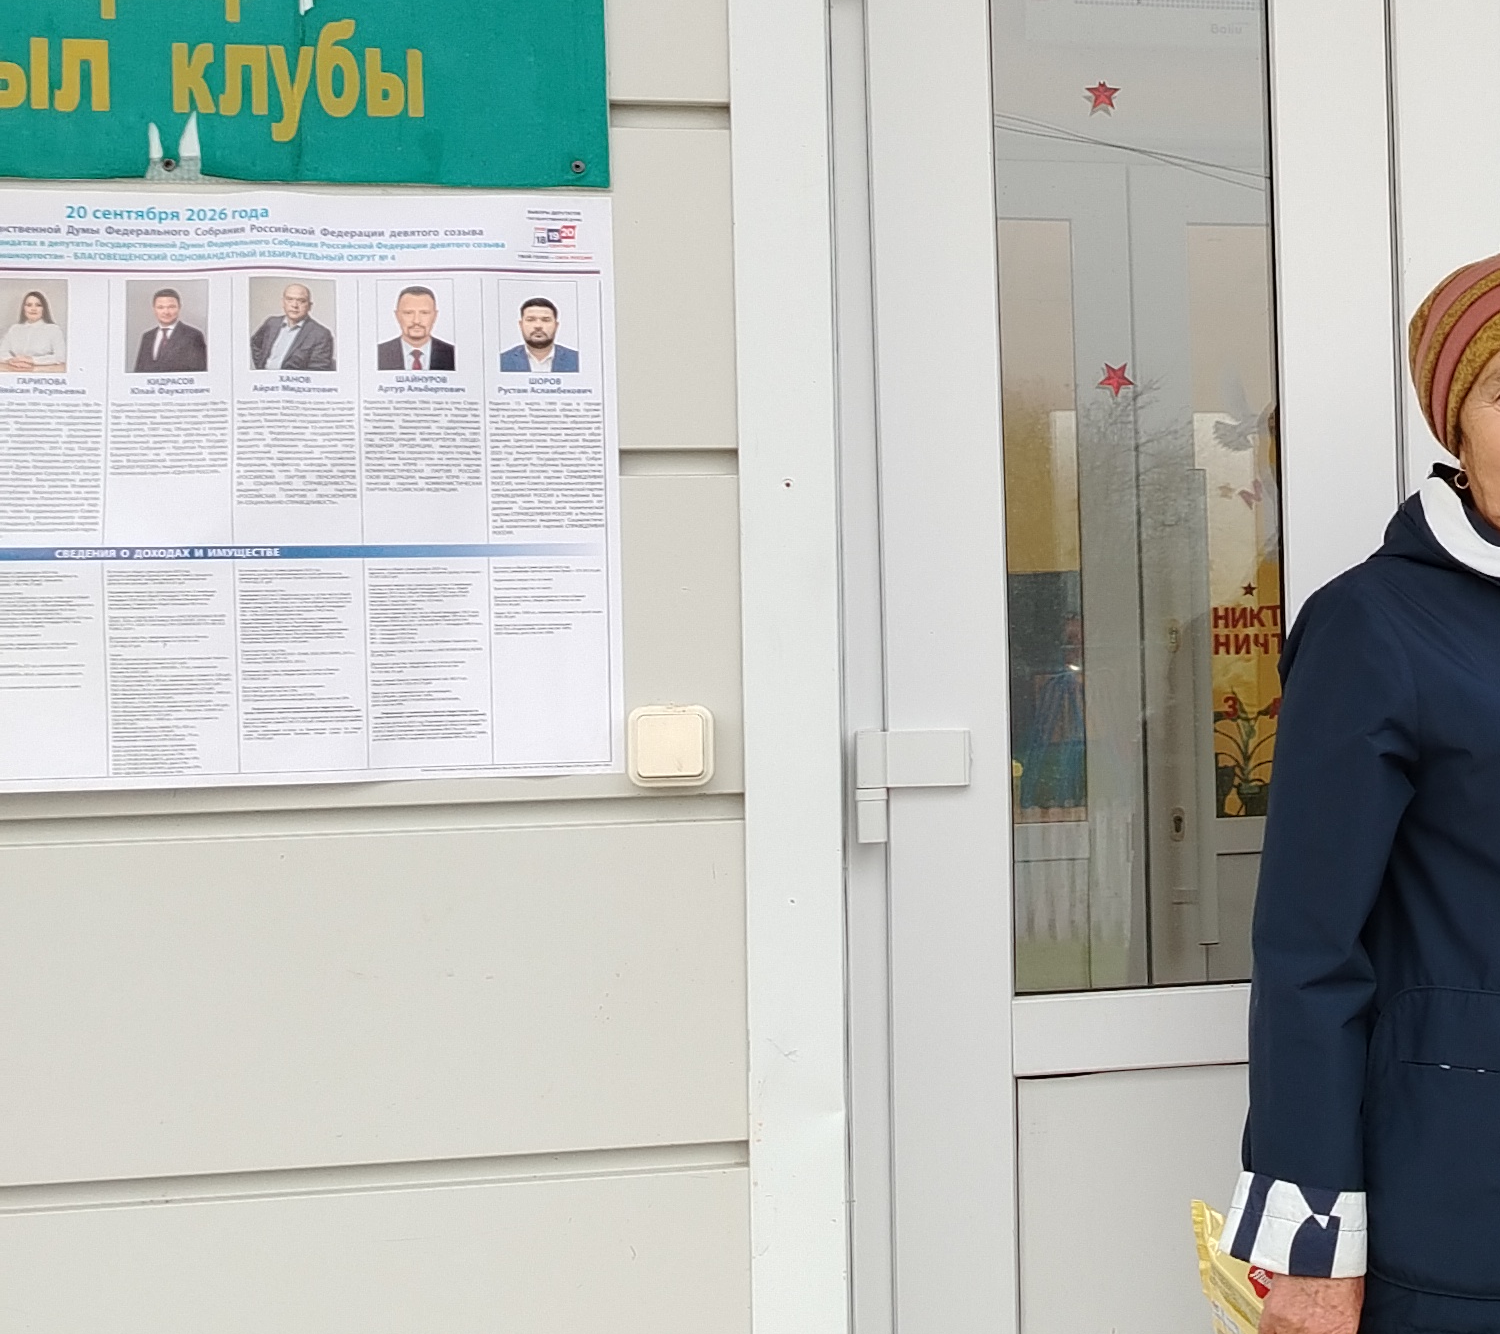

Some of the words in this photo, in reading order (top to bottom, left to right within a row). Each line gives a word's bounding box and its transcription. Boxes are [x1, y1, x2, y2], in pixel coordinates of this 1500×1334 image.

[172, 19, 425, 142] клубы
[66, 206, 87, 219] 20
[93, 206, 180, 223] сентября
[185, 208, 228, 221] 2026
[232, 207, 269, 221] года
[66, 225, 100, 236] Думы
[105, 226, 190, 237] Федерального
[195, 226, 245, 237] Собрания
[250, 224, 315, 236] Российской
[320, 228, 385, 239] Федерации
[389, 229, 439, 238] девятого
[444, 229, 484, 237] созыва
[561, 228, 575, 237] 20
[55, 548, 117, 560] СВЕДЕНИЯ
[133, 548, 191, 560] ДОХОДАХ
[207, 547, 281, 559] ИМУЩЕСТВЕ
